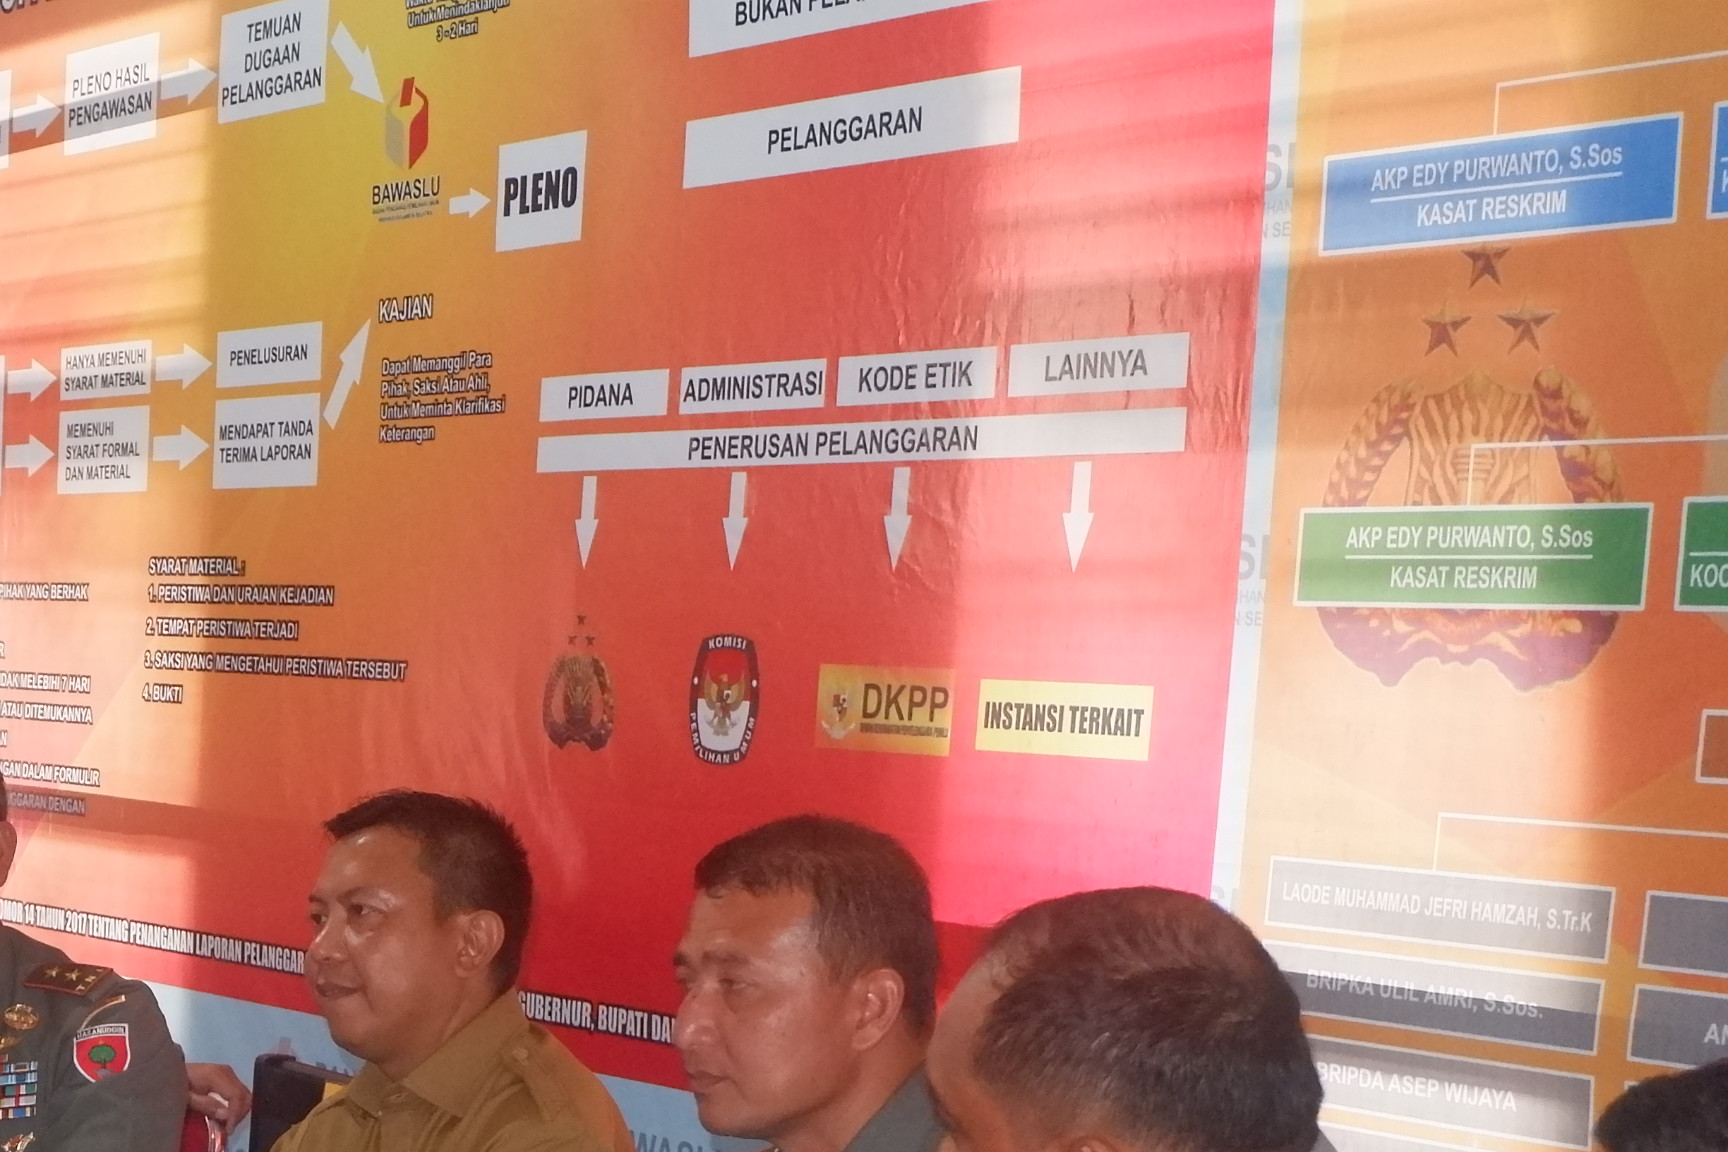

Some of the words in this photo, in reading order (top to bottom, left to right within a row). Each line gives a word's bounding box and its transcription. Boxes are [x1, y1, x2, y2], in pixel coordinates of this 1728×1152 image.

[458, 17, 478, 37] Hari
[735, 0, 802, 27] BUKAN
[246, 12, 302, 45] TEMUAN
[244, 42, 301, 74] DUGAAN
[72, 73, 111, 98] PLENO
[115, 67, 150, 91] HASIL
[221, 68, 322, 107] PELANGGARAN
[68, 91, 153, 128] PENGAWASAN
[767, 106, 923, 155] PELANGGARAN
[1371, 166, 1407, 192] AKP
[1412, 161, 1448, 188] EDY
[1453, 148, 1564, 183] PURWANTO,
[1569, 143, 1623, 171] S.Sos
[372, 175, 441, 205] BAWASLU
[503, 166, 578, 217] PLENO
[1417, 199, 1475, 228] KASAT
[1481, 189, 1567, 222] RESKRIM
[379, 294, 433, 323] KAJIAN
[65, 352, 95, 370] HANYA
[97, 348, 147, 367] MEMENUHI
[229, 344, 308, 367] PENELUSURAN
[382, 357, 411, 377] Dapat
[412, 351, 467, 375] Memanggil
[469, 350, 492, 368] Para
[1044, 348, 1148, 383] LAINNYA
[64, 375, 102, 393] SYARAT
[104, 371, 146, 390] MATERIAL
[381, 381, 411, 398] Pihak,
[413, 377, 441, 395] Saksi
[442, 375, 466, 393] Atau
[683, 370, 823, 403] ADMINISTRASI
[858, 363, 917, 394] KODE
[924, 360, 973, 390] ETIK
[380, 402, 410, 420] Untuk
[411, 398, 453, 418] Meminta
[455, 395, 506, 414] Klarifikasi
[568, 382, 634, 409] PIDANA
[67, 421, 114, 439] MEMENUHI
[219, 421, 274, 440] MENDAPAT
[277, 418, 314, 438] TANDA
[379, 425, 435, 444] Keterangan
[65, 444, 99, 460] SYARAT
[102, 441, 140, 458] FORMAL
[219, 446, 257, 464] TERIMA
[260, 443, 312, 462] LAPORAN
[688, 432, 809, 461] PENERUSAN
[815, 425, 979, 457] PELANGGARAN
[65, 466, 83, 481] DAN
[86, 463, 131, 480] MATERIAL
[1346, 526, 1382, 549] AKP
[1386, 525, 1422, 548] EDY
[1425, 524, 1535, 553] PURWANTO,
[1540, 524, 1593, 548] S.Sos
[149, 557, 187, 575] SYARAT
[188, 557, 239, 576] MATERIAL
[1390, 566, 1449, 588] KASAT
[1453, 565, 1537, 589] RESKRIM
[24, 583, 50, 600] YANG
[51, 583, 89, 601] BERHAK
[158, 583, 212, 602] PERISTIWA
[213, 585, 236, 603] DAN
[237, 586, 277, 605] URAIAN
[278, 586, 334, 606] KEJADIAN
[156, 617, 195, 638] TEMPAT
[196, 619, 252, 639] PERISTIWA
[252, 620, 299, 641] TERJADI
[708, 636, 747, 650] KOMISI
[154, 651, 185, 670] SAKSI
[185, 652, 214, 671] YANG
[215, 653, 285, 675] MENGETAHUI
[285, 657, 343, 678] PERISTIWA
[344, 658, 408, 682] TERSEBUT
[21, 673, 60, 692] MELEBIHI
[68, 675, 91, 694] HARI
[152, 684, 183, 704] BUKTI
[2, 701, 23, 719] ATAU
[24, 703, 93, 725] DITEMUKANNYA
[862, 683, 949, 723] DKPP
[983, 701, 1065, 734] INSTANSI
[1069, 705, 1145, 738] TERKAIT
[23, 761, 53, 780] DALAM
[54, 764, 100, 787] FORMULIR
[1282, 881, 1330, 906] LAODE
[1334, 886, 1421, 916] MUHAMMAD
[1424, 895, 1467, 920] JEFRI
[1471, 901, 1541, 931] HAMZAH,
[1547, 909, 1592, 933] S.Tr.K
[24, 903, 35, 926] 14
[36, 904, 65, 931] TAHUN
[65, 910, 87, 935] 2017
[88, 914, 129, 943] TENTANG
[130, 921, 194, 954] PENANGANAN
[195, 932, 242, 962] LAPORAN
[1306, 968, 1375, 997] BRIPKA
[1379, 977, 1421, 1003] ULIL
[1424, 984, 1479, 1012] AMRI,
[518, 990, 594, 1031] GUBERNUR,
[598, 1005, 648, 1040] BUPATI
[1316, 1062, 1384, 1092] BRIPDA
[1388, 1073, 1440, 1100] ASEP
[1444, 1081, 1517, 1112] WIJAYA
